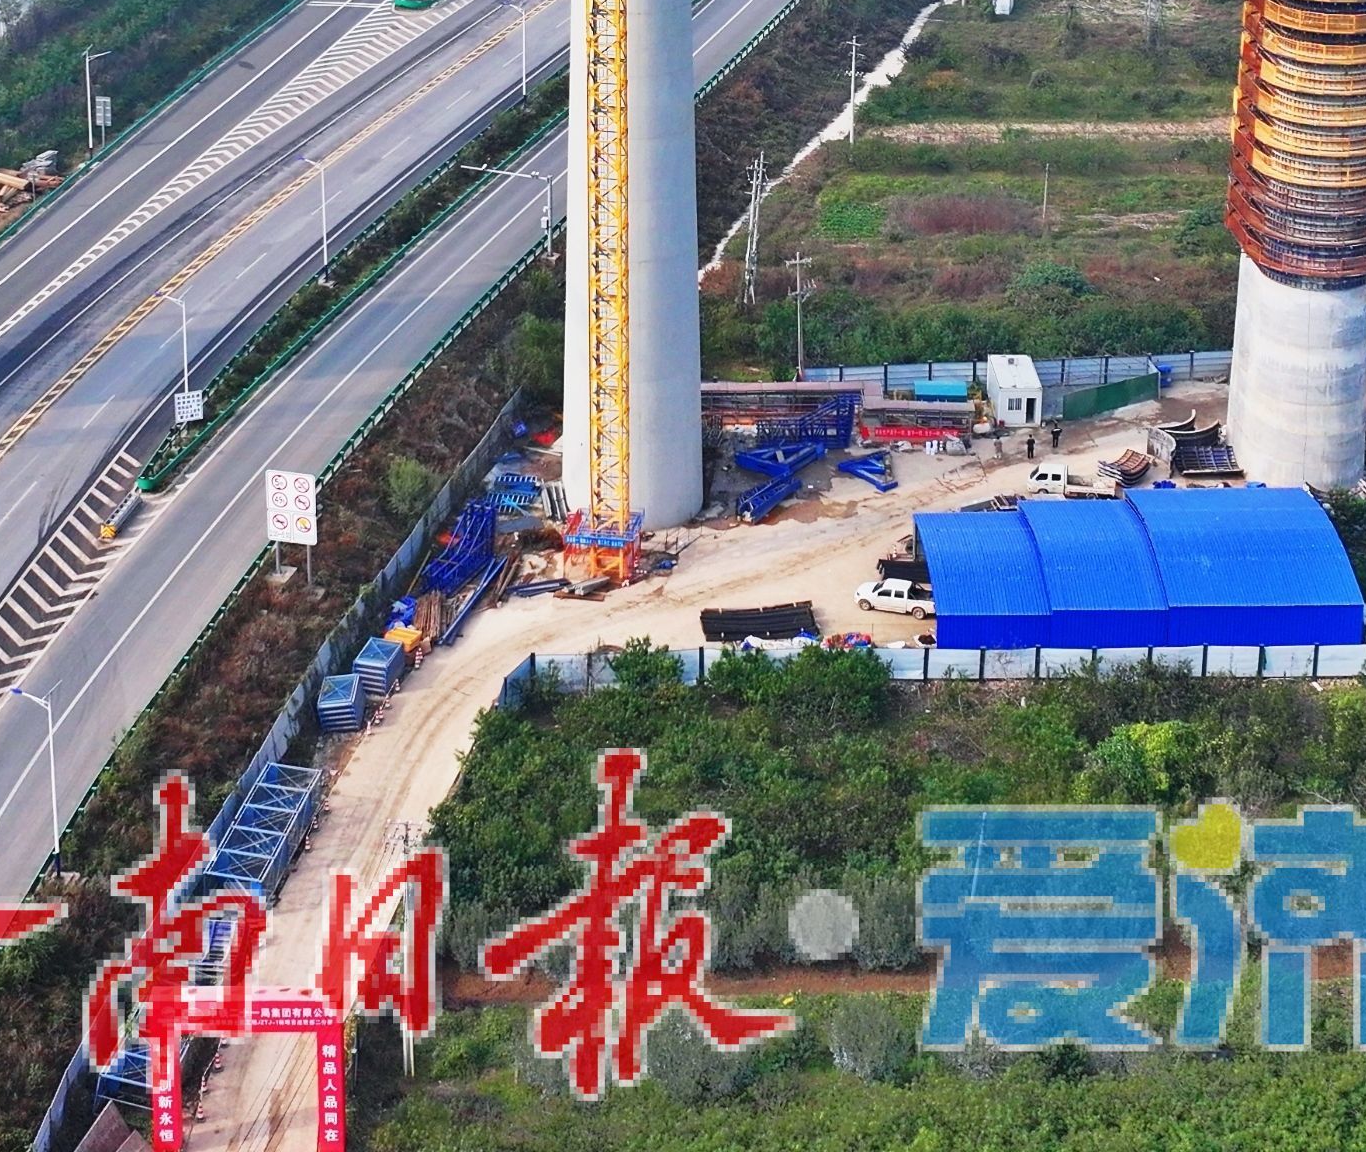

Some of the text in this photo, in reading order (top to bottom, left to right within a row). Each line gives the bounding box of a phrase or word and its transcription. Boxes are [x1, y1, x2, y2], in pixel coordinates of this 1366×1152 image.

[321, 1044, 339, 1142] 精品人品同在
